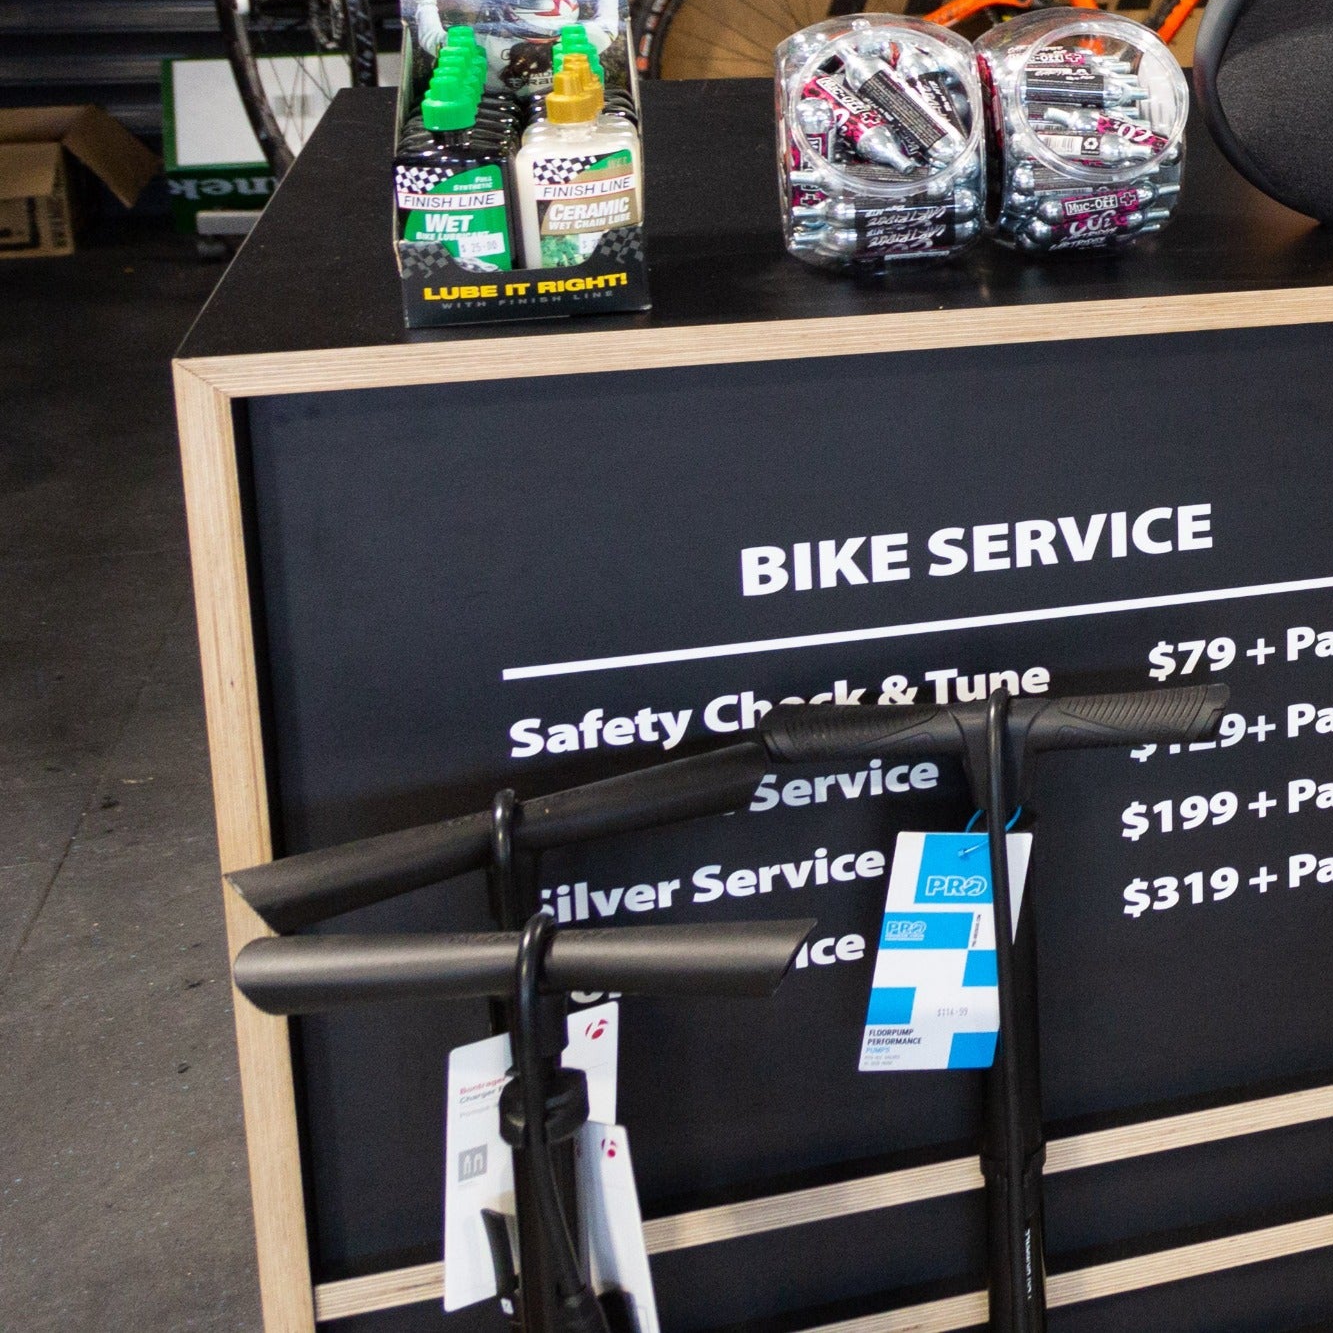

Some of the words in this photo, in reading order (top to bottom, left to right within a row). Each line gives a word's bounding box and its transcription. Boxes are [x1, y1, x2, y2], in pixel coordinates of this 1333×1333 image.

[544, 184, 595, 197] FINISH
[600, 177, 630, 192] LINE
[403, 196, 452, 208] FINISH
[458, 194, 495, 207] LINE
[549, 197, 630, 221] CERAMIC
[1067, 196, 1116, 214] Muc-Off
[425, 213, 474, 233] WET
[549, 221, 571, 230] WET
[574, 217, 605, 229] CHAIN
[608, 212, 631, 224] LUBE
[424, 285, 498, 300] LUBE
[505, 283, 530, 296] IT
[537, 273, 628, 294] RIGHT!
[442, 301, 487, 309] WITH
[498, 296, 561, 306] FINISH
[573, 291, 613, 300] LINE
[741, 532, 911, 596] BIKE
[928, 503, 1213, 577] SERVICE
[1149, 636, 1236, 682] $79
[1246, 638, 1276, 664] +
[509, 708, 692, 757] Safety
[878, 674, 917, 705] &
[924, 667, 1050, 705] Tune
[749, 758, 938, 812] Service
[1122, 791, 1238, 841] $199
[1248, 791, 1277, 818] +
[692, 848, 886, 903] Service
[925, 875, 988, 896] PRO
[1123, 867, 1239, 917] $319
[1249, 866, 1277, 893] +
[885, 920, 927, 934] PRO
[867, 1037, 921, 1045] PERFORMANCE
